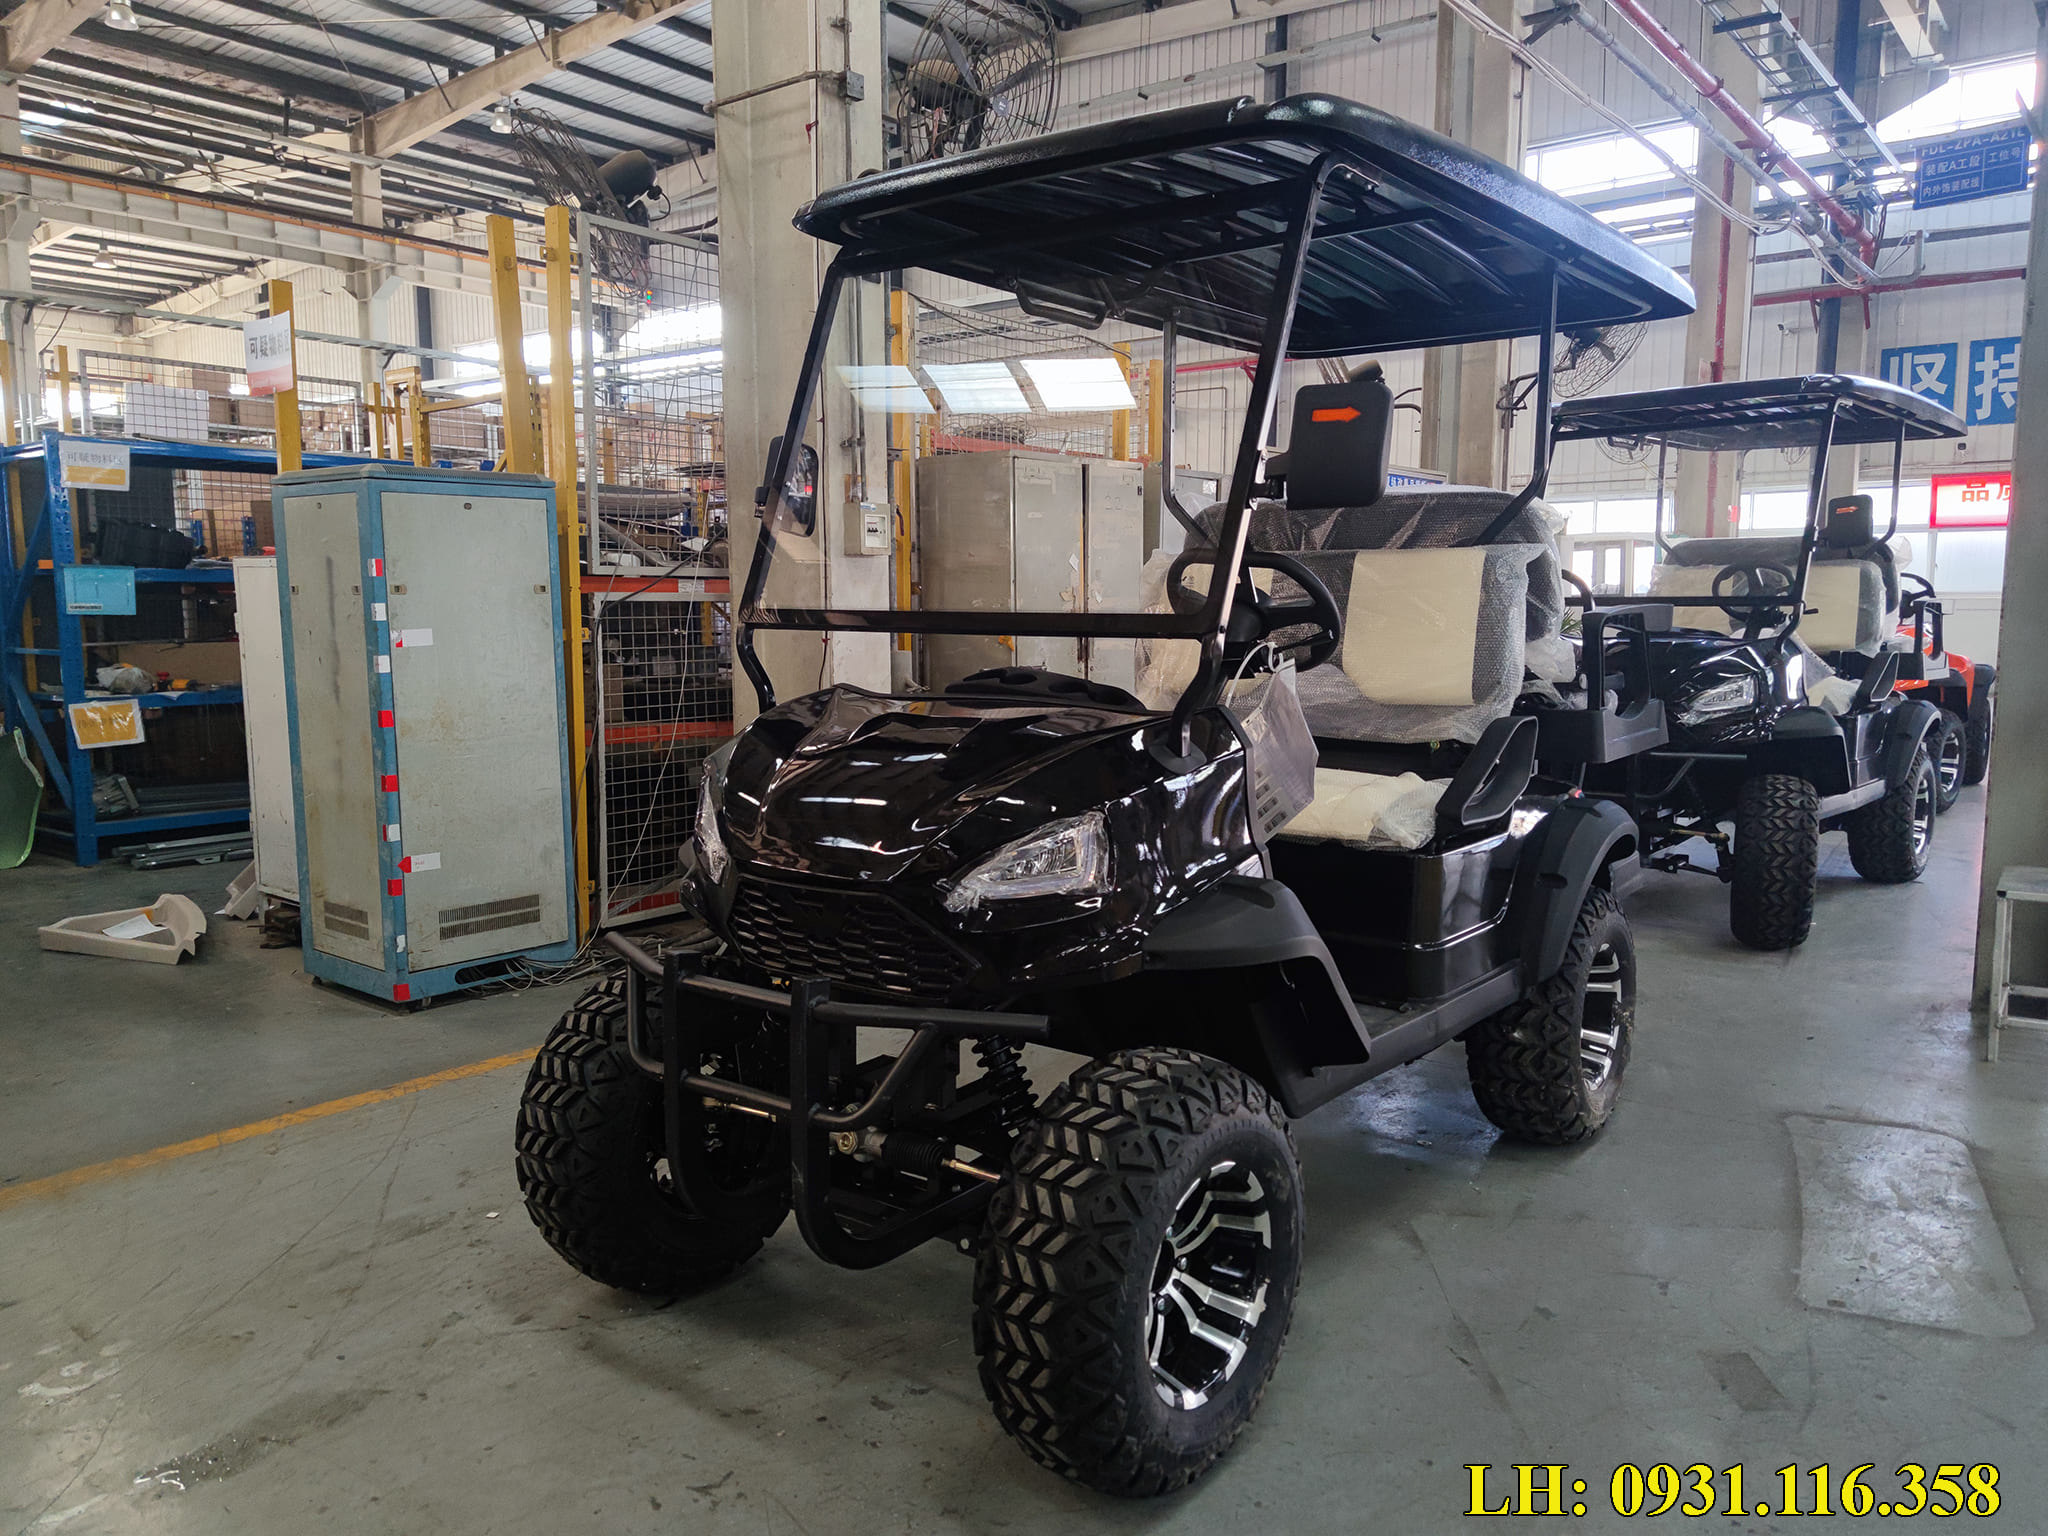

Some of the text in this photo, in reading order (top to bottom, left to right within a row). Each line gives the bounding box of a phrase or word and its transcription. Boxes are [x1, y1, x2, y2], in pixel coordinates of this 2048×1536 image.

[1987, 146, 2021, 163] 工位号
[1925, 154, 1981, 177] 装配A工段
[1922, 176, 1980, 197] 内外饰装配线
